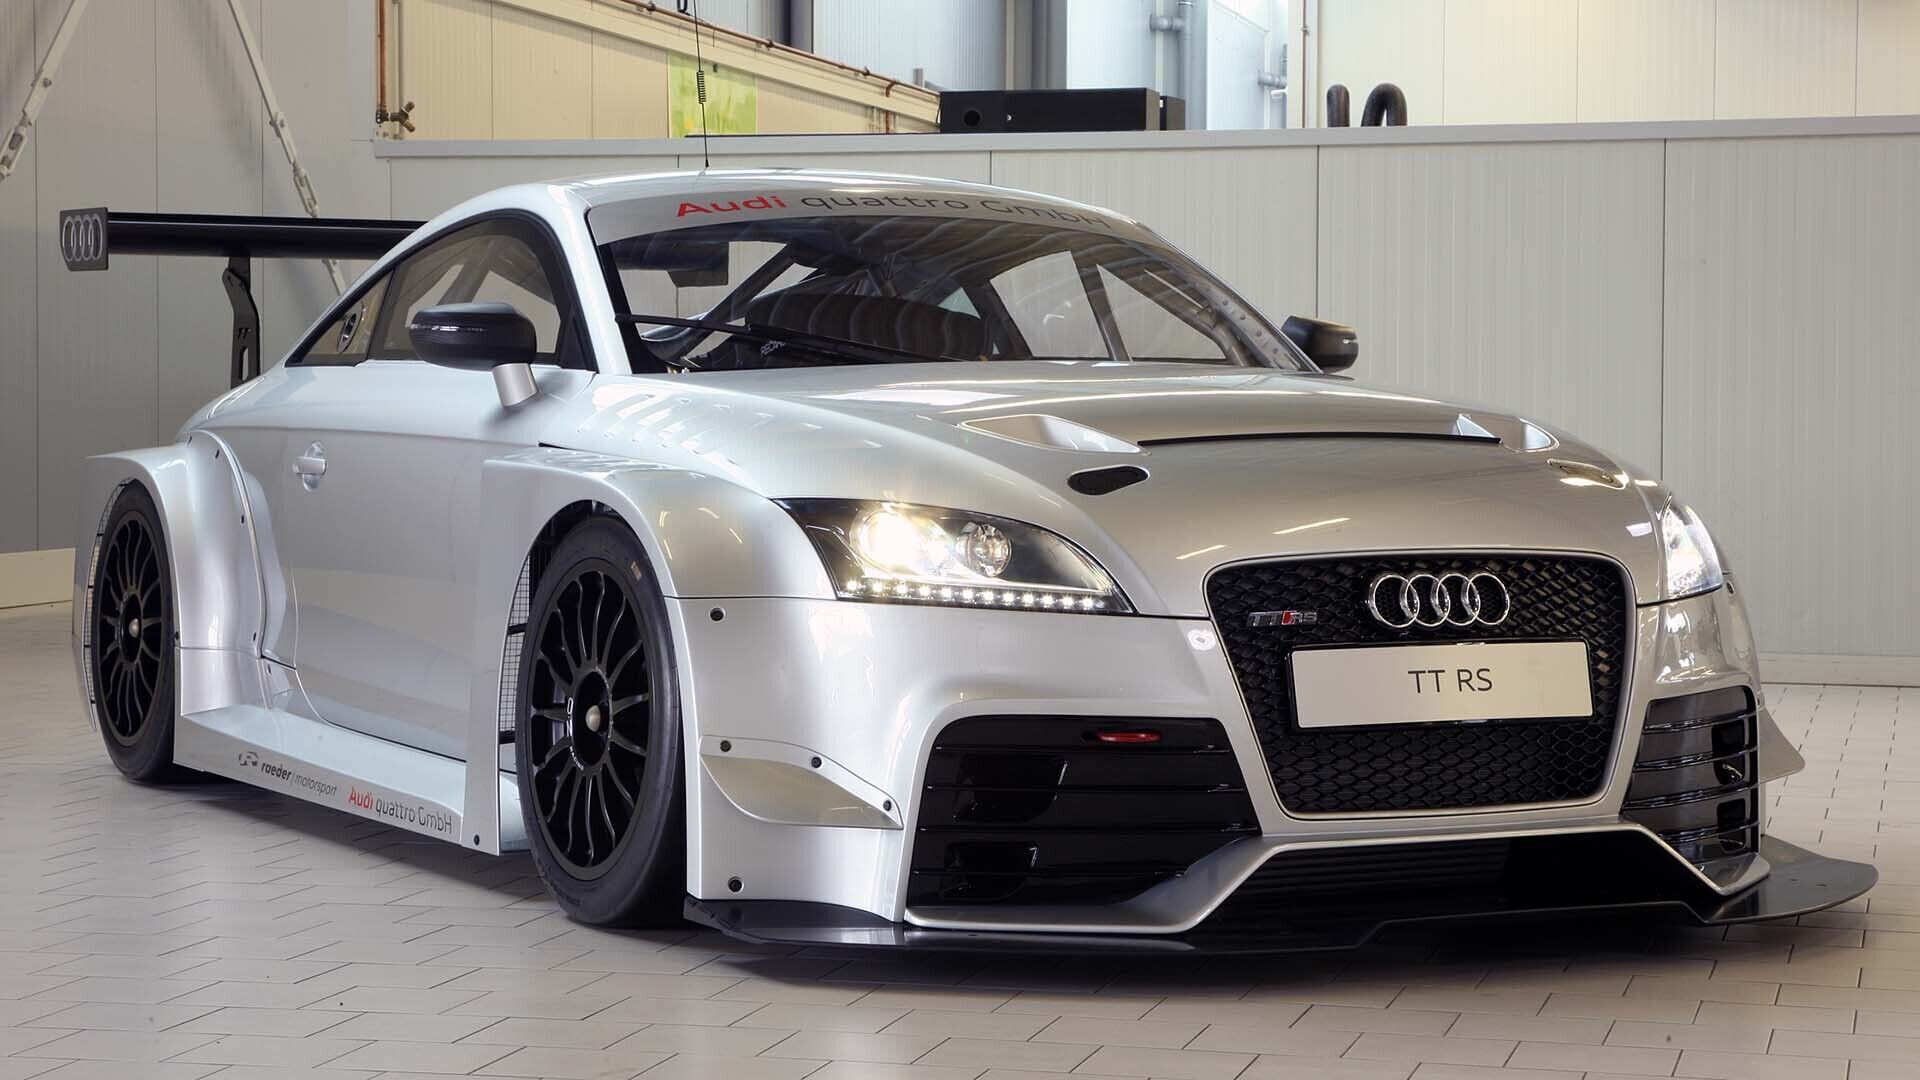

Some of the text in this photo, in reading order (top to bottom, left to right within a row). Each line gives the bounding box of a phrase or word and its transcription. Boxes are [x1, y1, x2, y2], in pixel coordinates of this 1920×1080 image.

[677, 196, 1111, 229] Audi quattro GmbH
[1408, 668, 1492, 693] TT RS
[261, 762, 337, 796] raeder motorsport
[348, 786, 452, 834] Audi quattro GmbH
